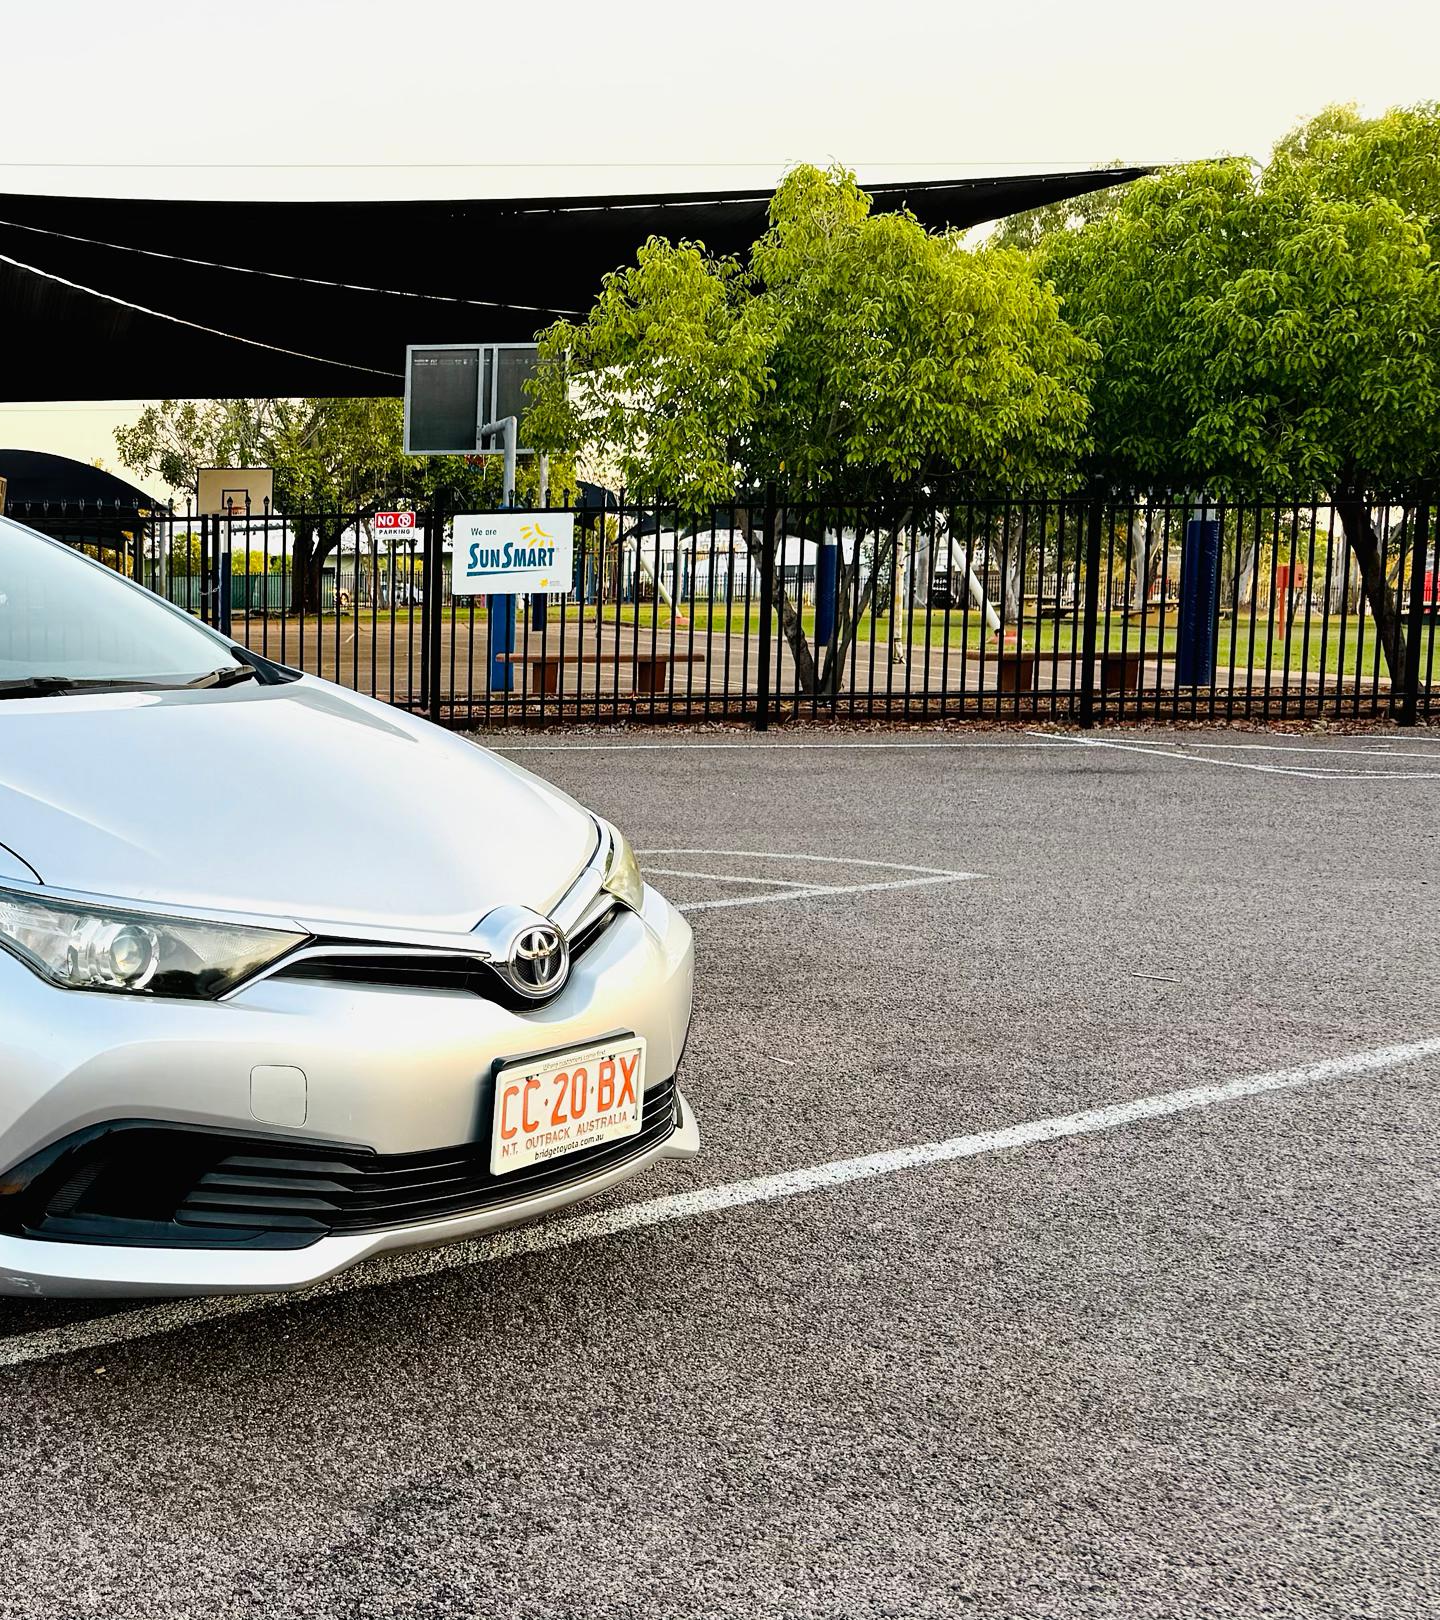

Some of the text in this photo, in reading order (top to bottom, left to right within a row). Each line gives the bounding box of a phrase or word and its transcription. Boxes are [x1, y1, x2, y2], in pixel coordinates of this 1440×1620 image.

[377, 515, 395, 526] NO
[470, 527, 497, 536] We are
[501, 1112, 627, 1158] N.T. OUTBACK AUSTRALIA
